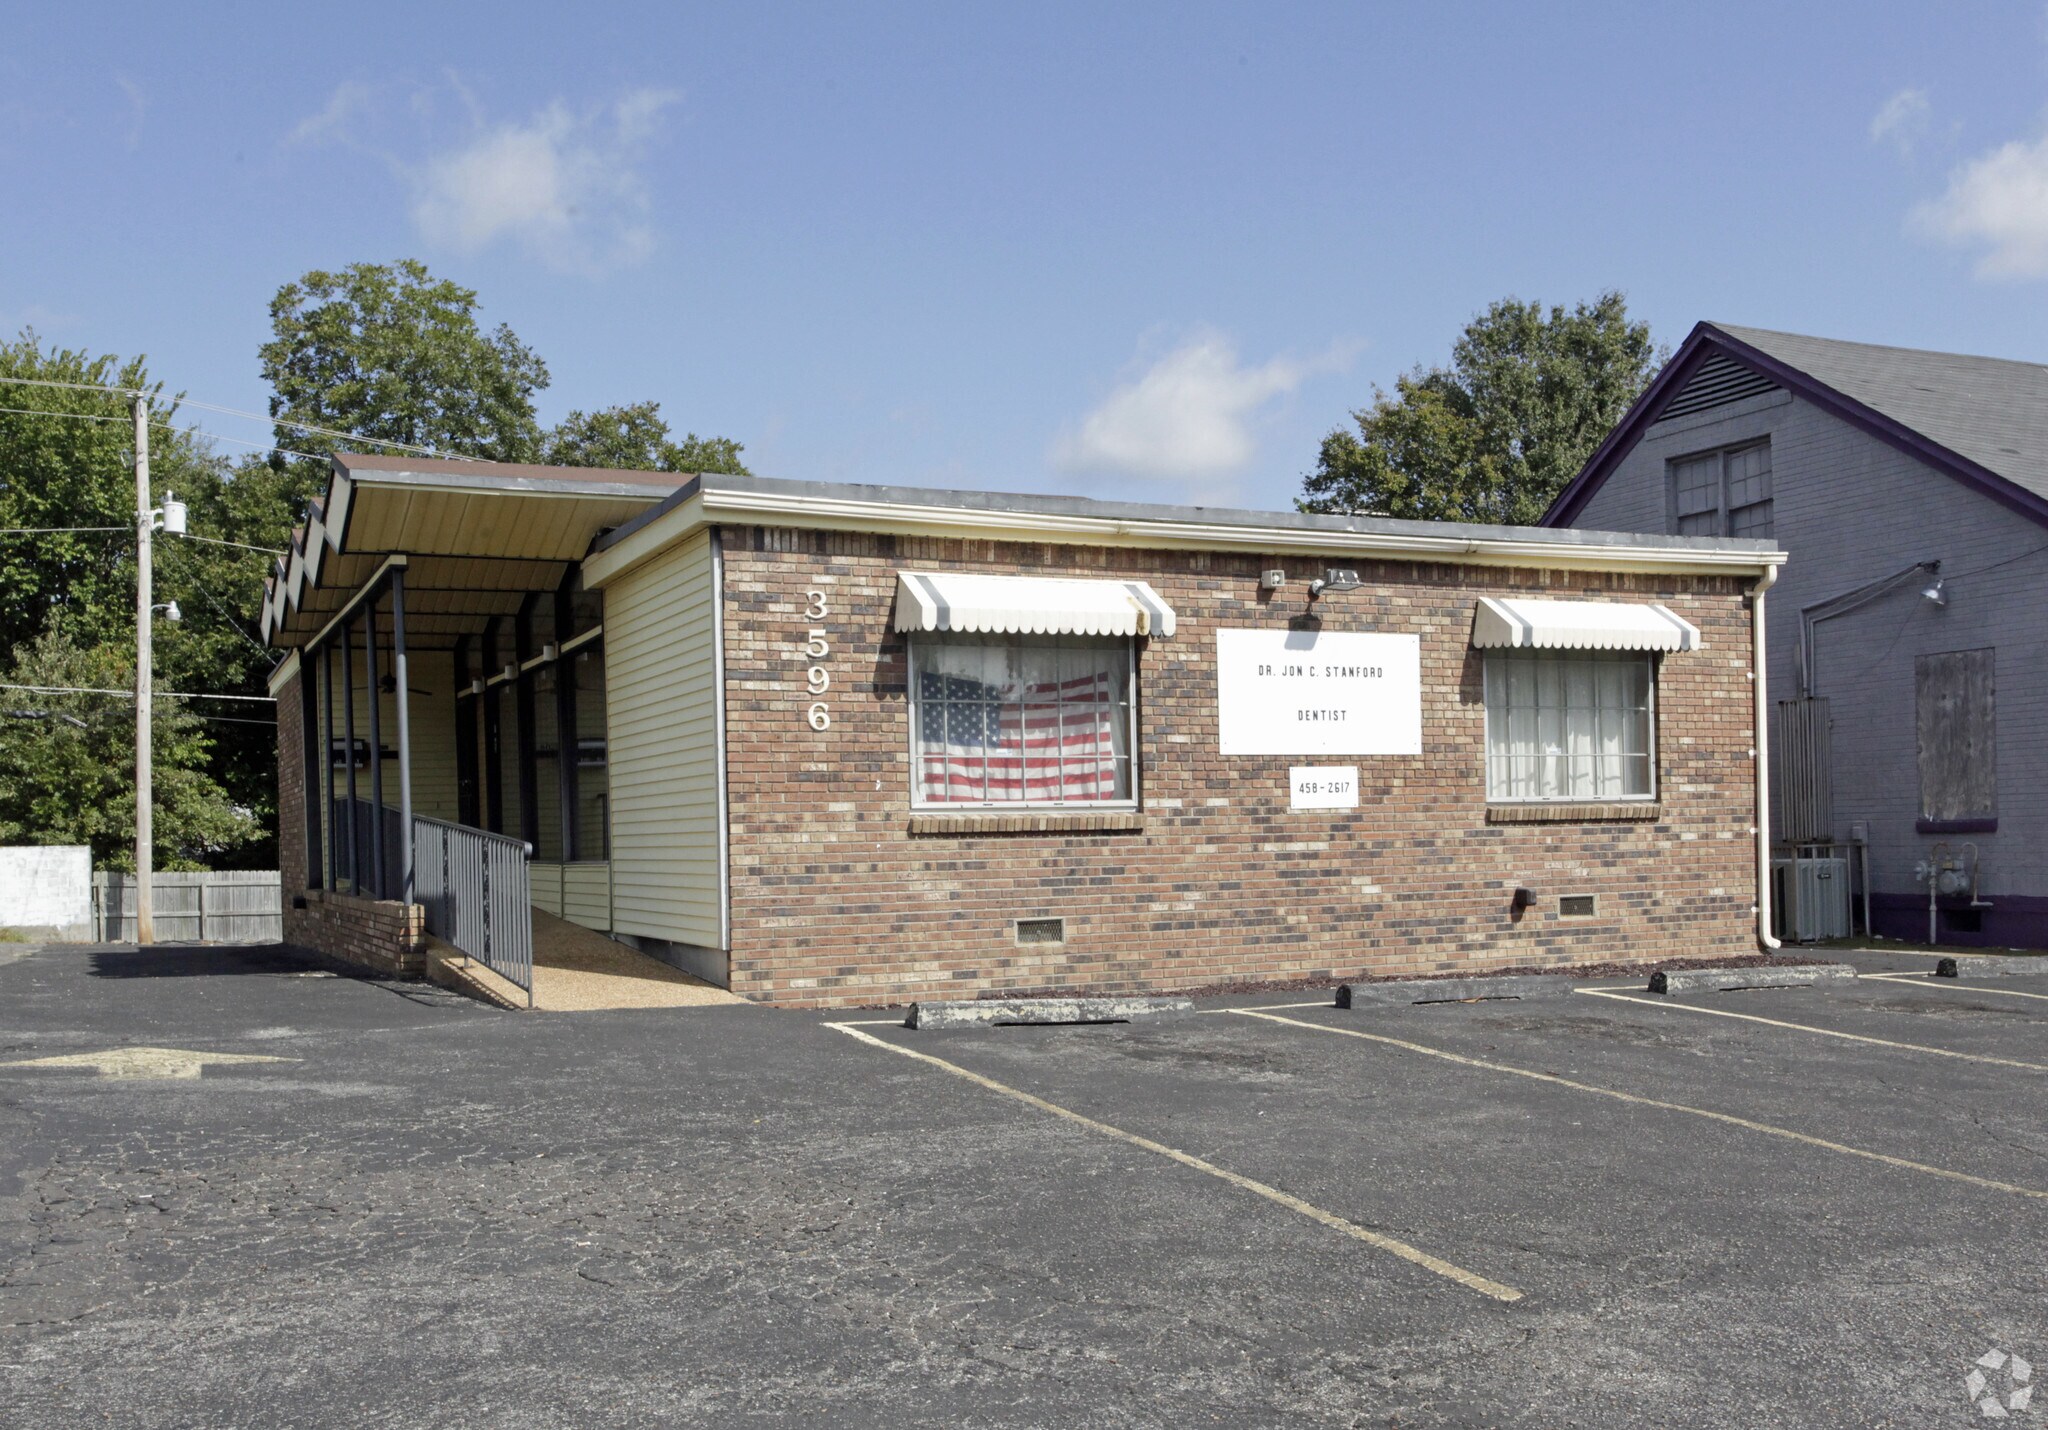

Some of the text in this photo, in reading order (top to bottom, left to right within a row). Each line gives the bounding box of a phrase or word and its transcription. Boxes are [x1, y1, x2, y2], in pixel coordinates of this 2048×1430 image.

[804, 590, 831, 732] 3596
[1258, 664, 1383, 678] DR. JON C. STANFORD
[1297, 709, 1347, 721] DENTIST
